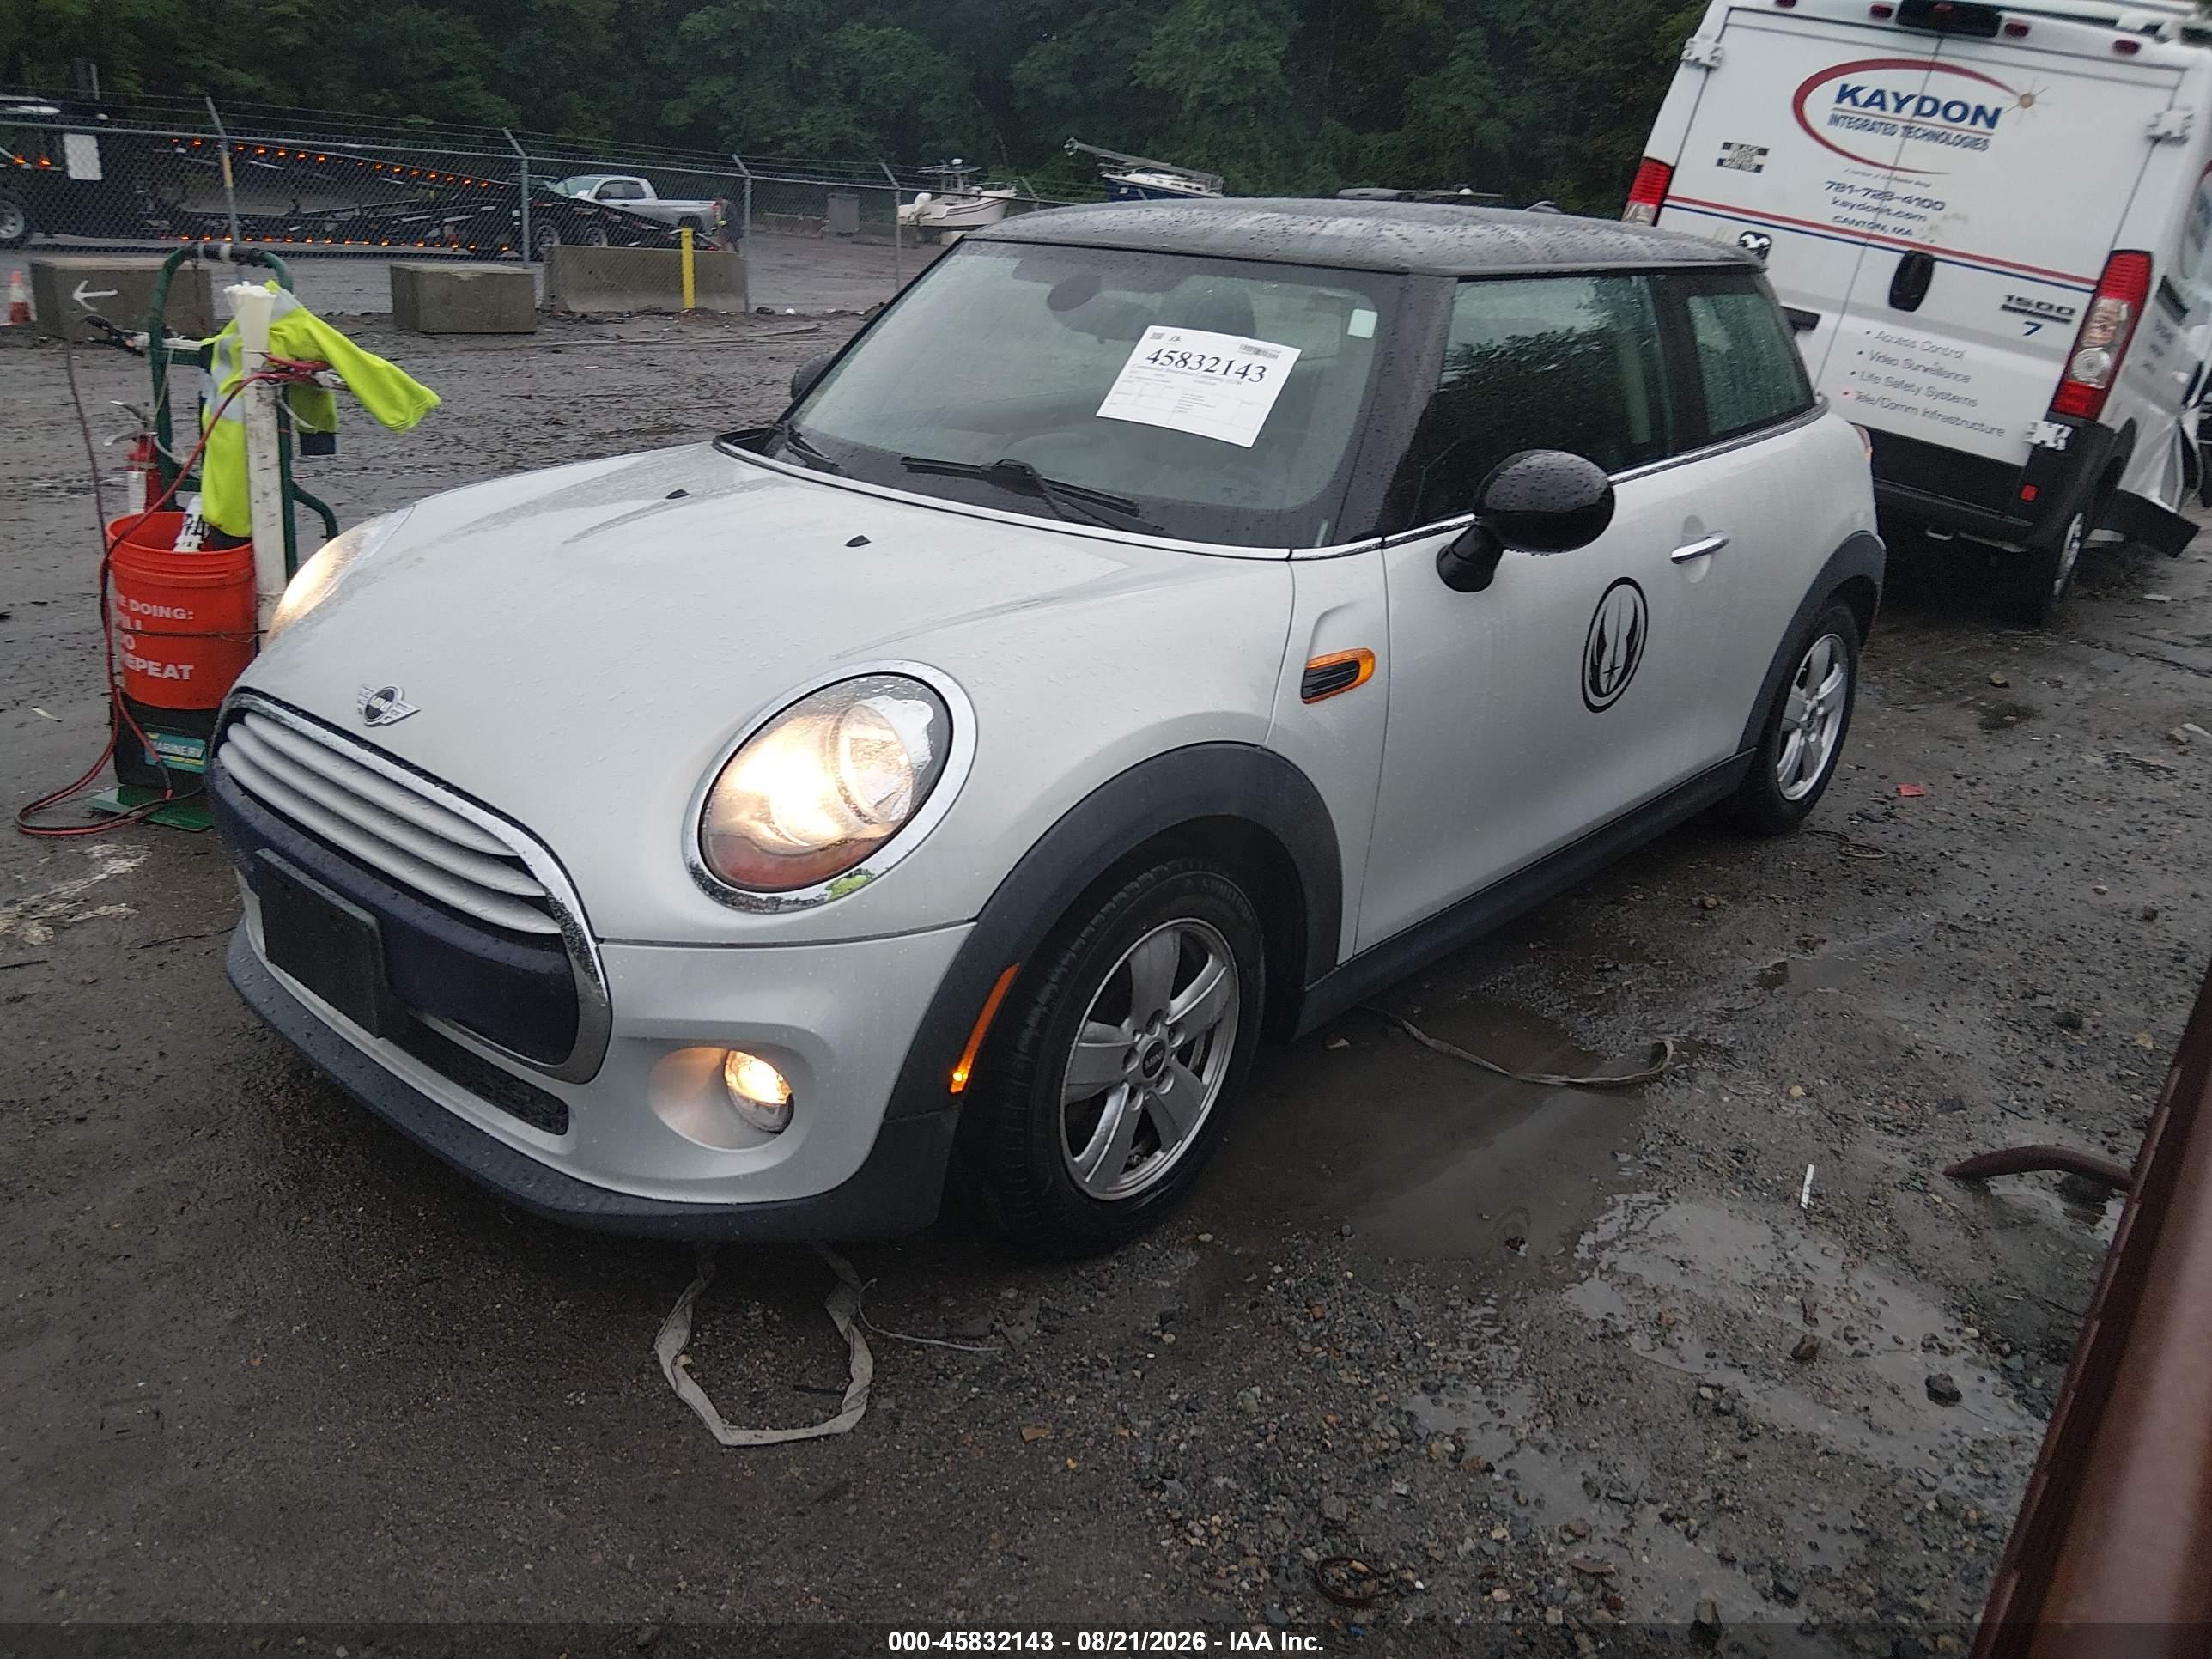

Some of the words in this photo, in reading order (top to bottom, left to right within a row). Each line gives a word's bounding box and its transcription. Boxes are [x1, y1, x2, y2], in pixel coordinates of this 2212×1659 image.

[1834, 83, 2002, 129] KAYDON
[1826, 112, 1899, 137] INTEGRATED
[1899, 125, 1991, 152] TECHNOLOGIES
[2004, 295, 2075, 316] 1500
[2021, 320, 2044, 337] 7
[1868, 349, 1899, 367] Video
[1875, 331, 1917, 349] Access
[1920, 340, 1966, 359] Control
[1146, 348, 1267, 384] 45832143
[1855, 390, 1919, 416] Tele/Comm
[1859, 370, 1881, 385] Life
[1883, 375, 1923, 396] Safety
[1923, 385, 1978, 409] Systems
[128, 599, 194, 620] DOING:
[122, 653, 194, 680] EPEAT
